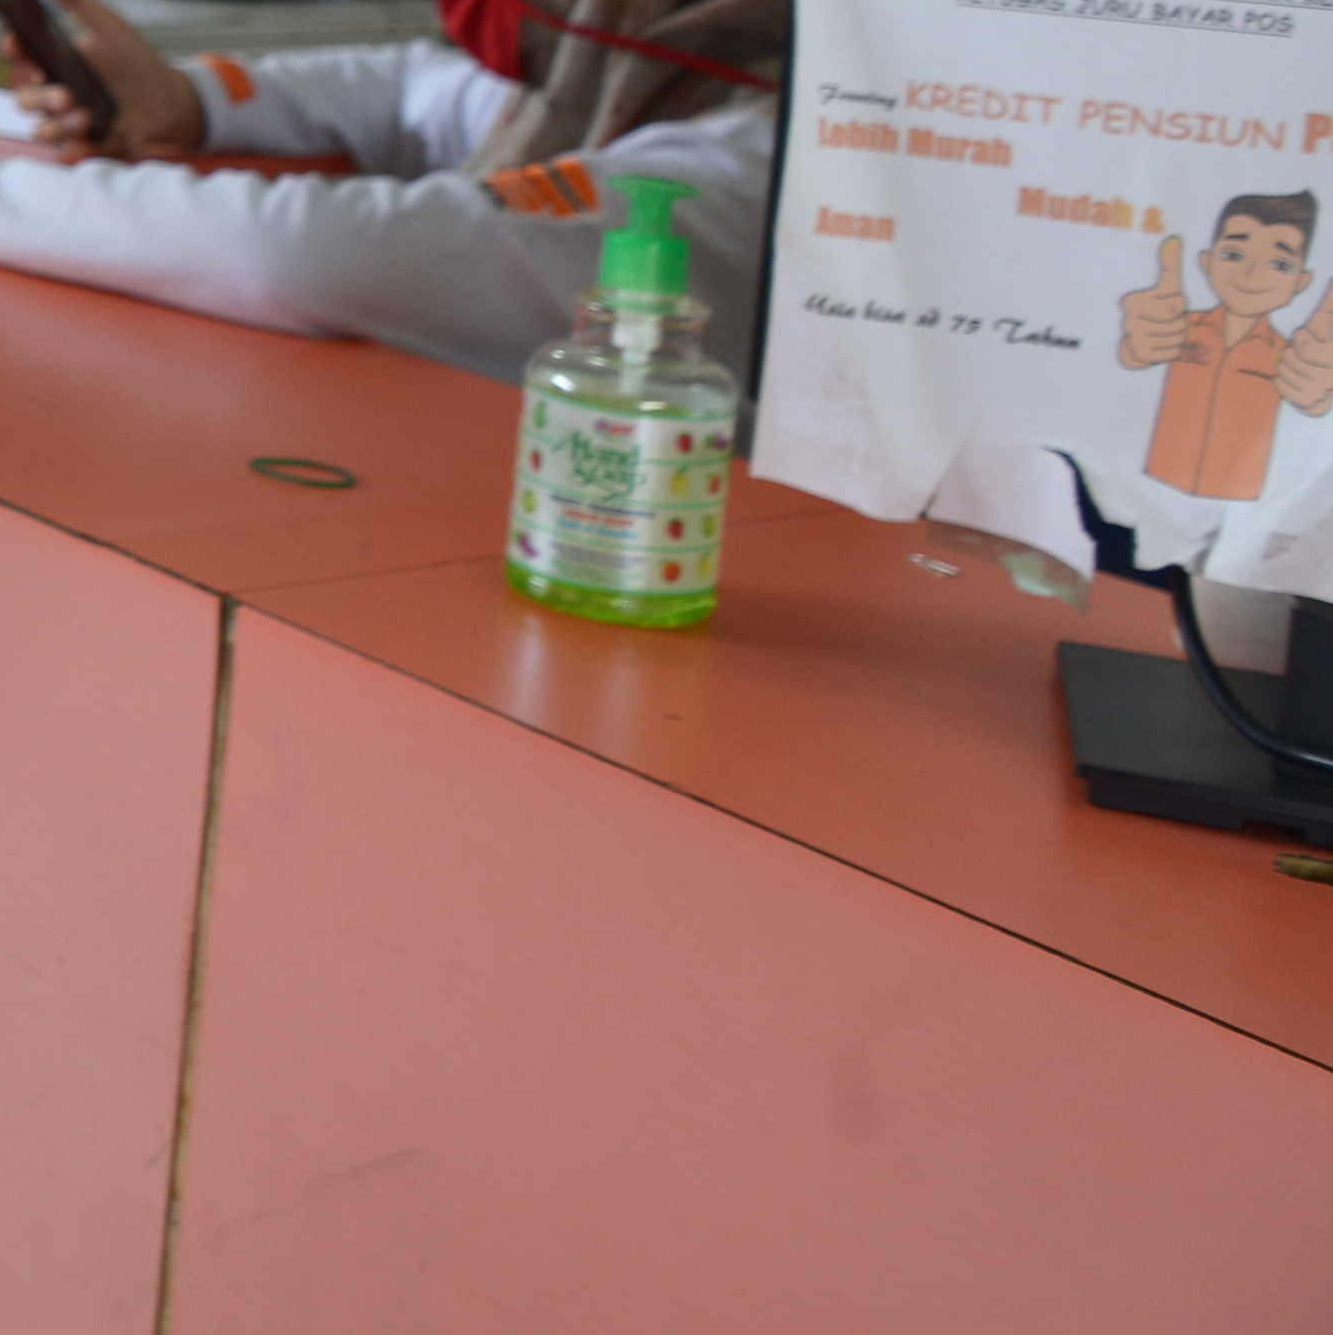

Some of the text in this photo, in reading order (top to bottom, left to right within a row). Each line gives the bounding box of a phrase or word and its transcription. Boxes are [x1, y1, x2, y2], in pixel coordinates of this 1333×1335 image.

[1151, 2, 1234, 26] BAYAR
[1245, 10, 1295, 34] POS
[905, 81, 1063, 124] KREDIT
[1078, 97, 1287, 152] PENSIUN
[817, 117, 1014, 169] Lebih Murah
[814, 206, 896, 244] Aman
[1016, 184, 1135, 231] Mudah
[950, 314, 982, 335] 75
